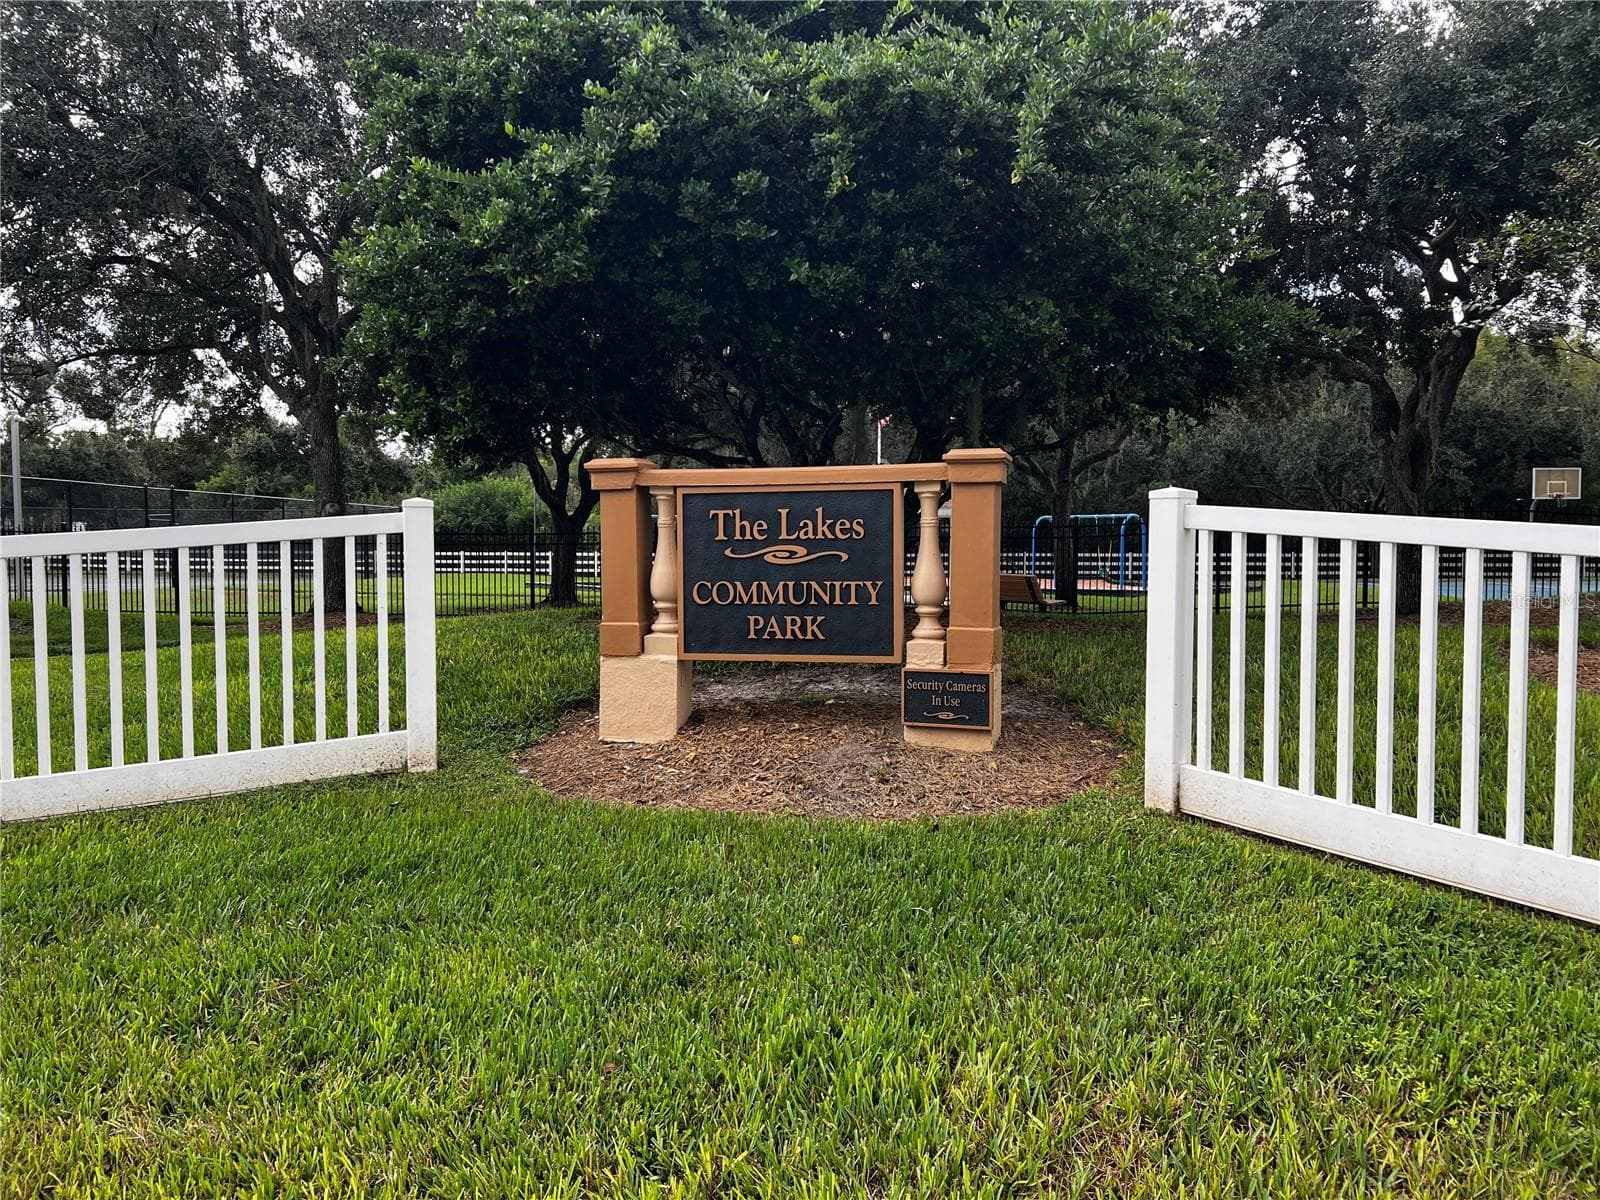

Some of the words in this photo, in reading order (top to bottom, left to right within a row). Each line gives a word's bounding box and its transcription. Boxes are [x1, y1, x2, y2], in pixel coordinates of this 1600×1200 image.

[709, 508, 768, 541] The
[777, 506, 865, 541] Lakes
[692, 581, 883, 605] COMMUNITY
[747, 615, 826, 640] PARK
[906, 678, 944, 693] Security
[945, 680, 986, 693] Cameras
[932, 695, 942, 706] In
[943, 695, 961, 707] Use
